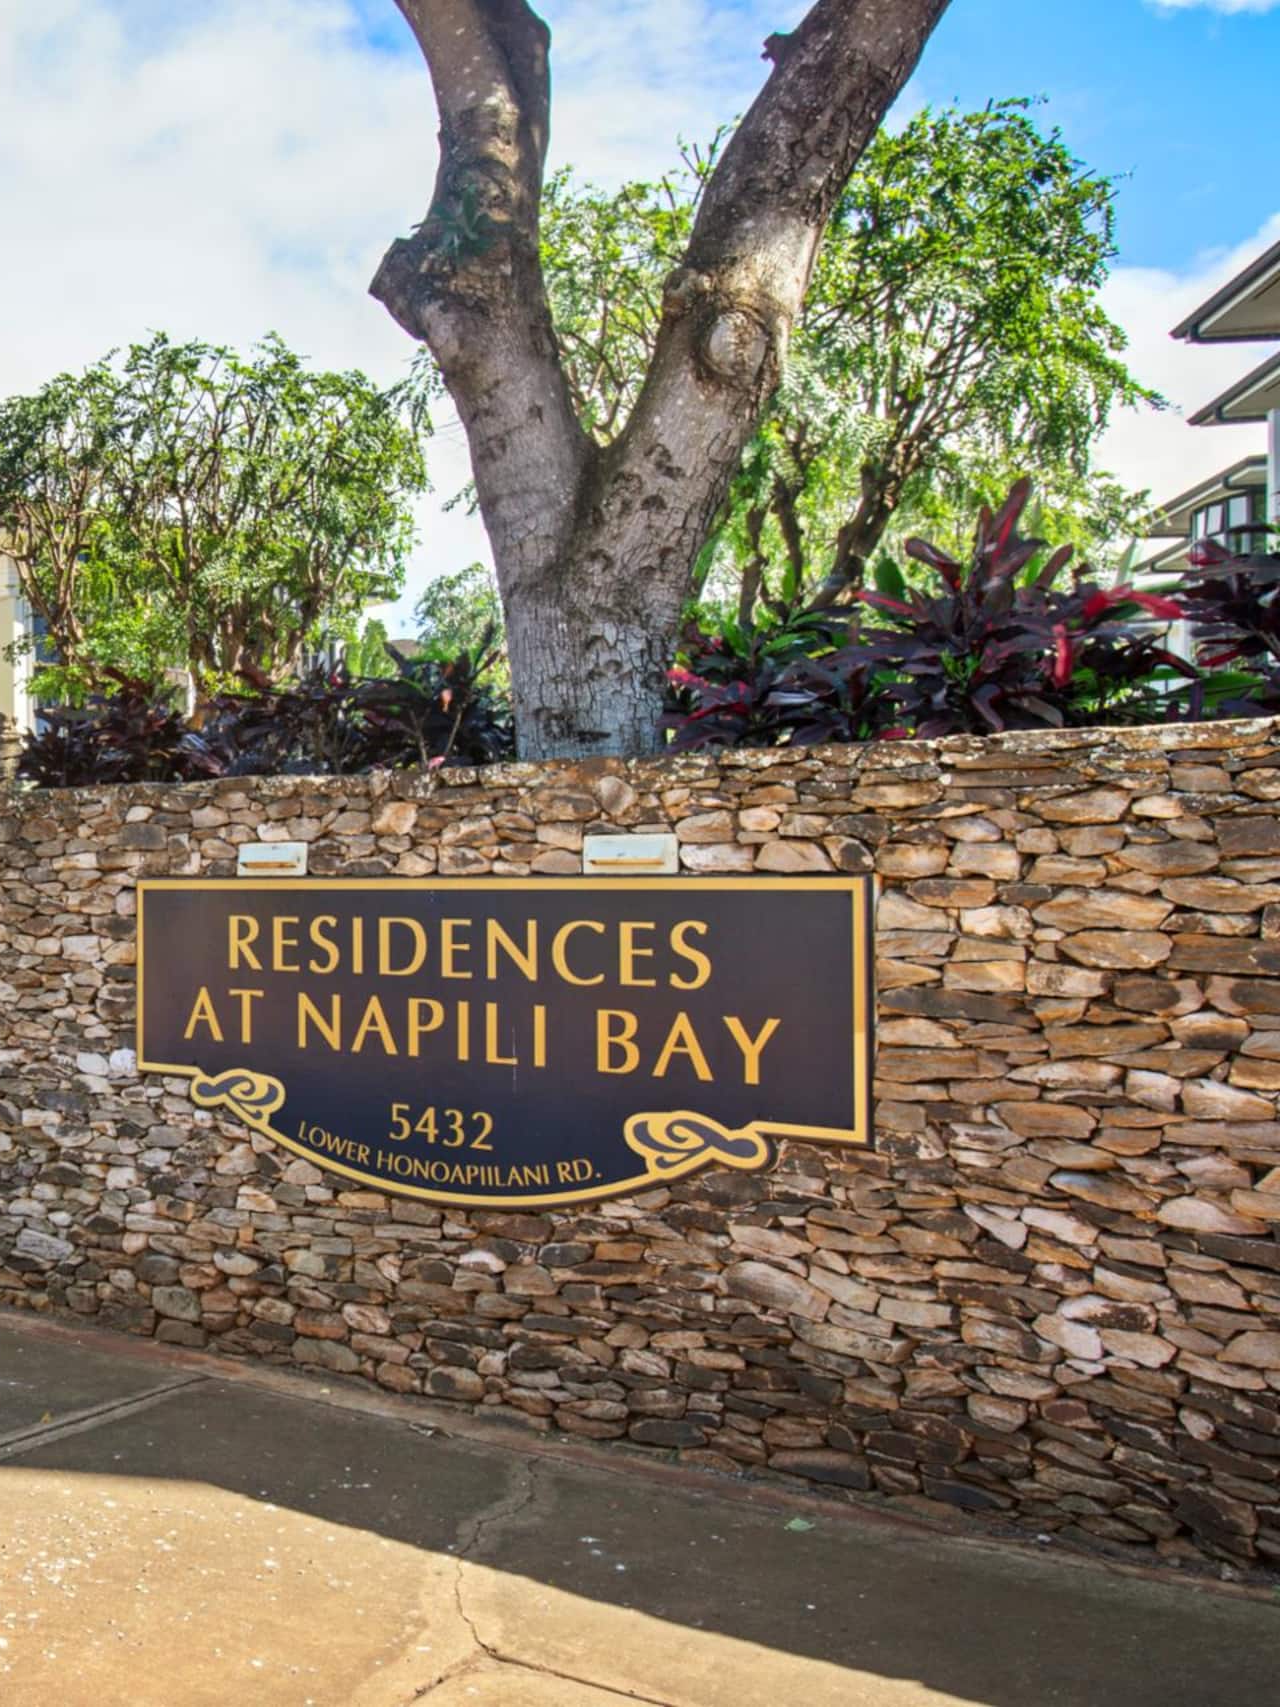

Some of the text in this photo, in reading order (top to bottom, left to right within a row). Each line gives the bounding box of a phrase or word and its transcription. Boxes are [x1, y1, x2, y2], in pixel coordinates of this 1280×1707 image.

[227, 913, 713, 991] RESIDENCES
[183, 985, 782, 1086] AT NAPILI BAY
[297, 1119, 603, 1187] LOWER HONOAPIILANI RD.
[389, 1102, 494, 1151] 5432
